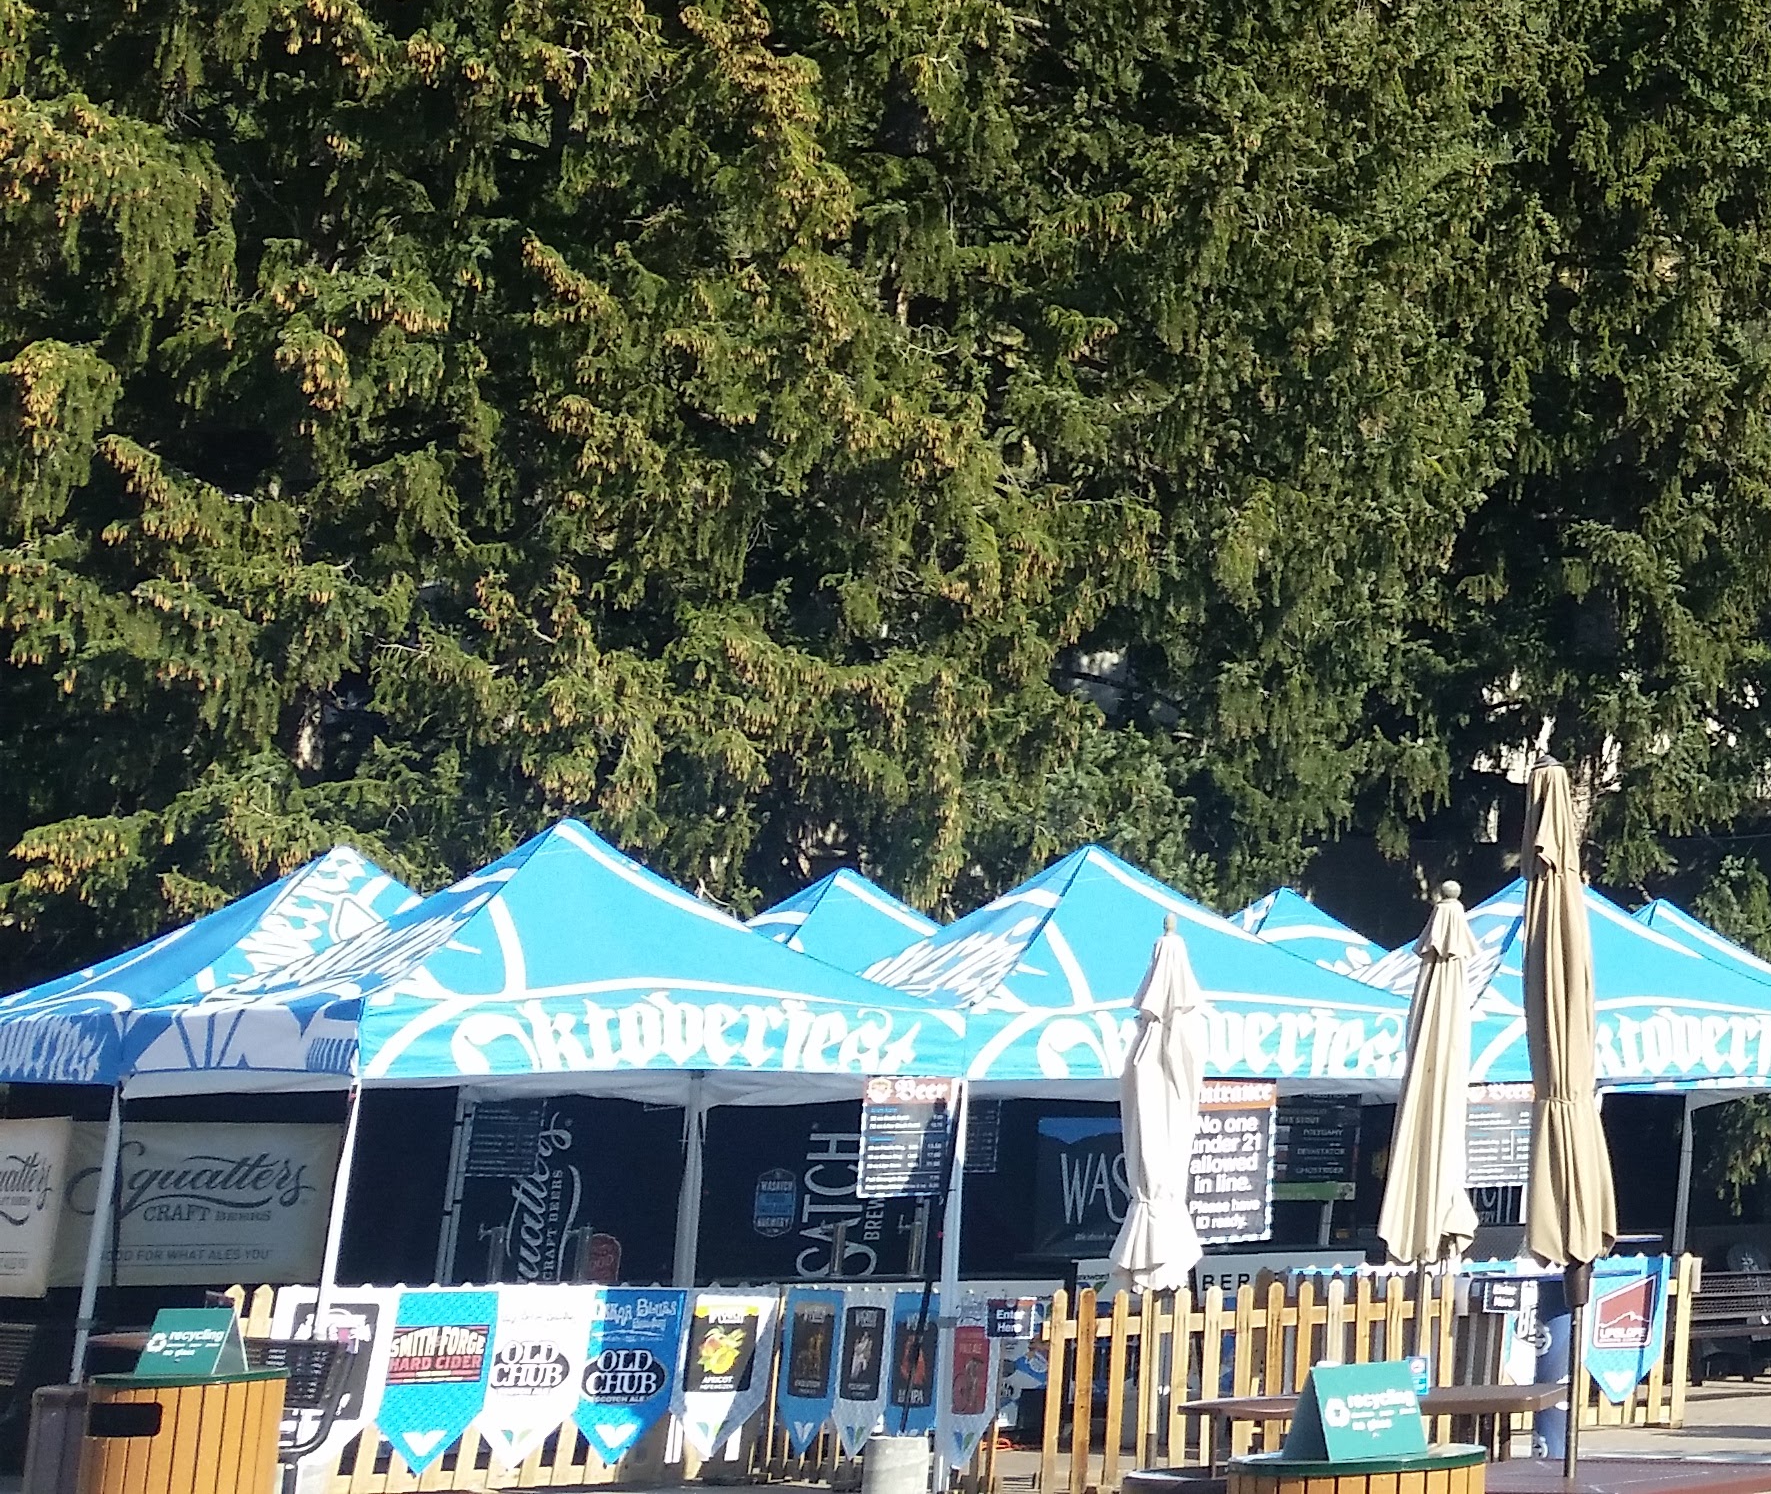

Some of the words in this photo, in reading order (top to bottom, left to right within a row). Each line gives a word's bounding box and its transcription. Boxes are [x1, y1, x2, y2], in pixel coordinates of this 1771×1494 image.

[451, 990, 921, 1075] Oktoberfest
[1200, 1083, 1272, 1103] ntrance
[1195, 1116, 1221, 1134] No
[1224, 1116, 1258, 1132] one
[1242, 1134, 1261, 1152] 21
[1190, 1153, 1258, 1174] allowed
[65, 1141, 316, 1219] Squatters
[1195, 1176, 1212, 1193] in
[1215, 1175, 1252, 1193] line.
[508, 1112, 572, 1282] uatters
[1190, 1200, 1230, 1214] Please
[1231, 1199, 1260, 1210] have
[143, 1204, 210, 1221] CRAFT
[167, 1249, 205, 1261] WHAT
[208, 1248, 240, 1260] ALES
[996, 1309, 1025, 1320] Enter
[169, 1329, 224, 1342] recycling
[997, 1322, 1022, 1333] Here
[390, 1327, 434, 1357] SMITH
[438, 1326, 486, 1355] FORGE
[501, 1340, 560, 1364] OLD
[597, 1349, 653, 1371] OLD
[389, 1356, 430, 1371] HARD
[435, 1355, 481, 1369] CIDER
[491, 1363, 562, 1387] CHUB
[586, 1371, 657, 1394] CHUB
